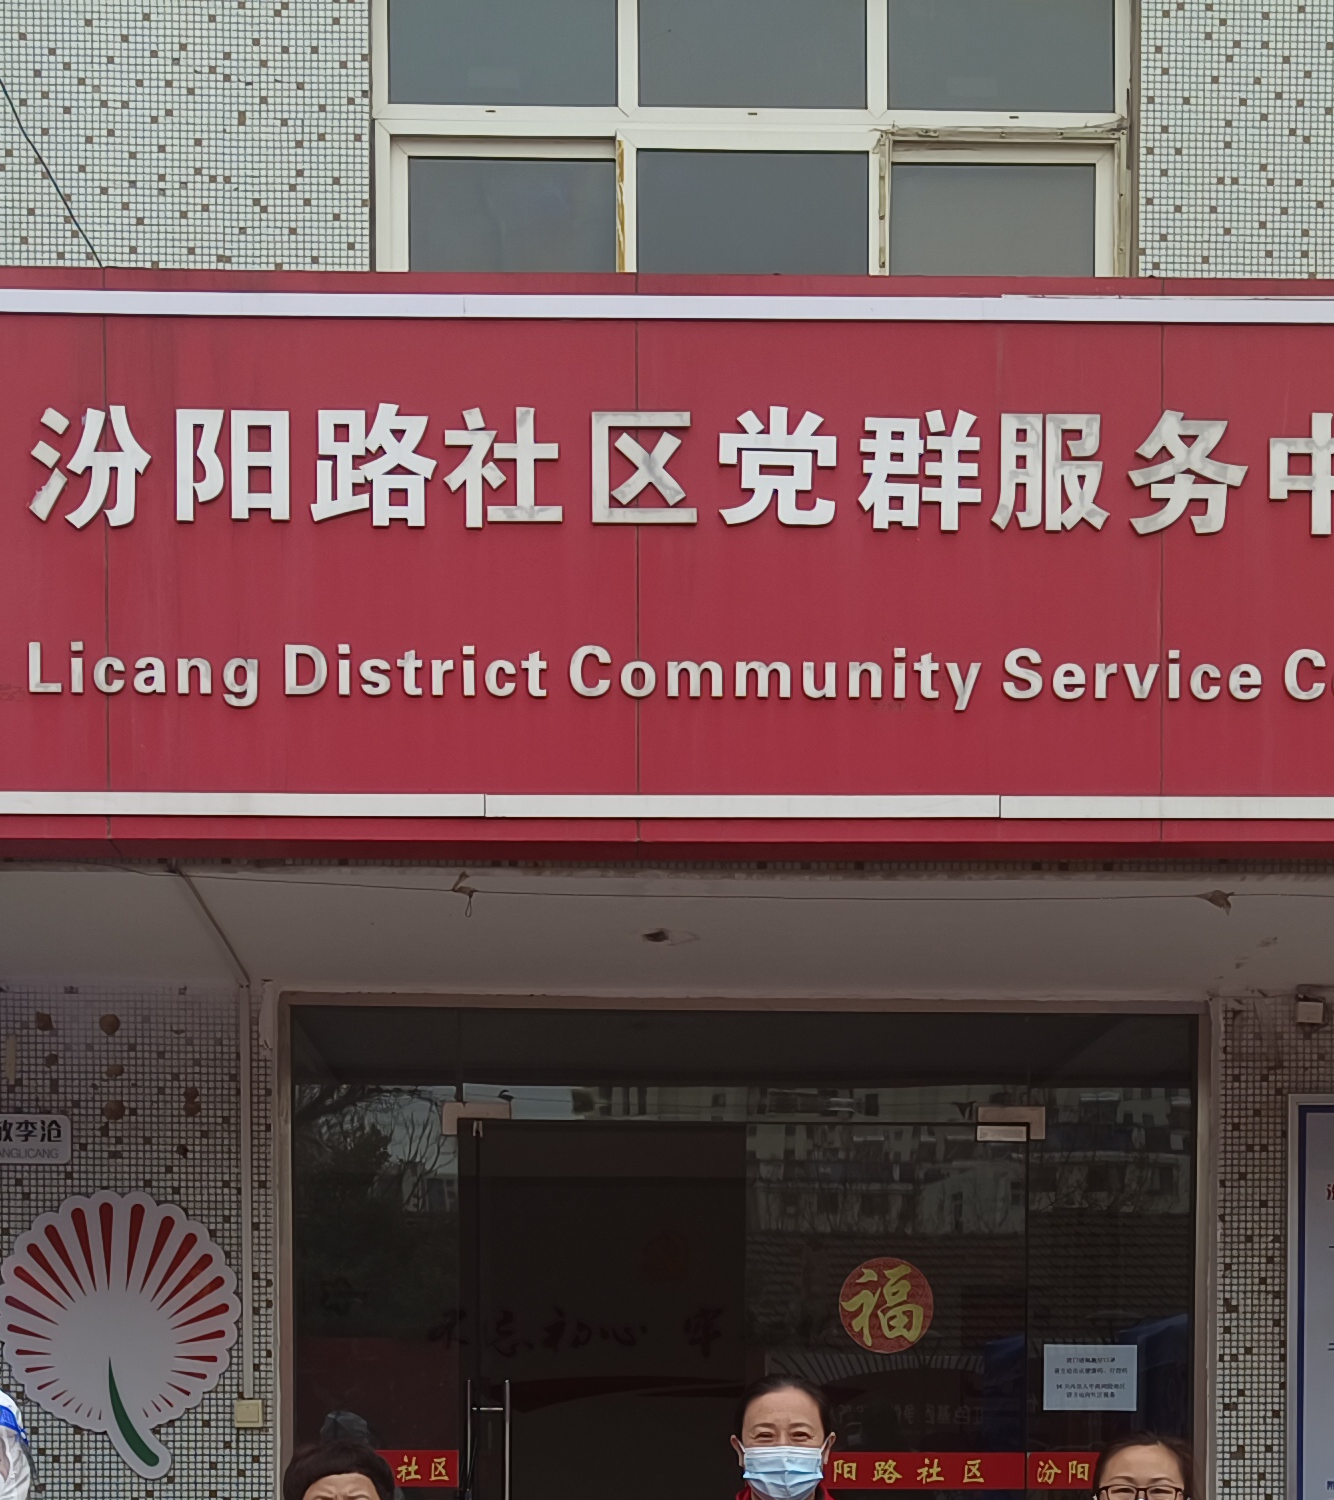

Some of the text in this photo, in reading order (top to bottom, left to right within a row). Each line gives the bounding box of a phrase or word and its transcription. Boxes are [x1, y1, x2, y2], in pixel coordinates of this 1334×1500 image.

[26, 640, 259, 708] Licang
[284, 641, 548, 700] District
[567, 643, 983, 712] Community
[1000, 646, 1264, 704] Service
[841, 1264, 924, 1347] 福
[395, 1454, 450, 1483] 社区
[832, 1458, 985, 1485] 阳路社区
